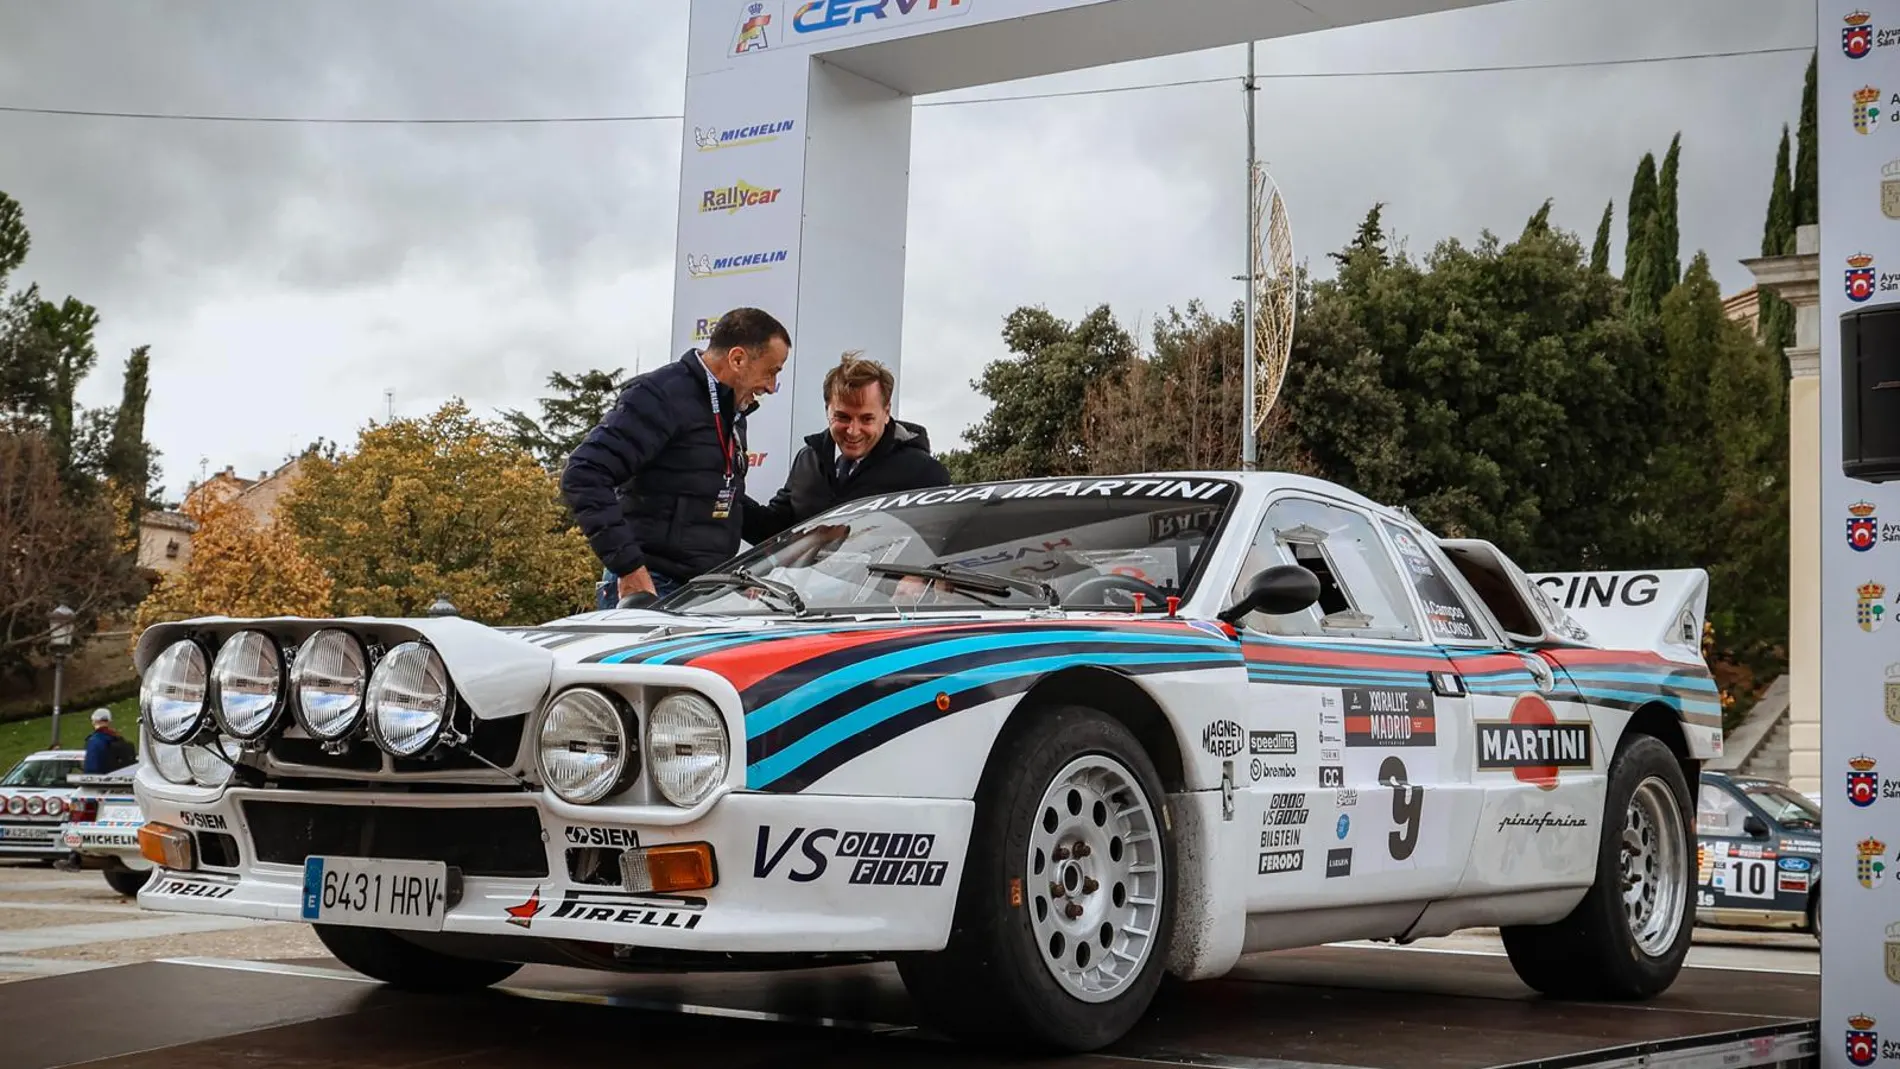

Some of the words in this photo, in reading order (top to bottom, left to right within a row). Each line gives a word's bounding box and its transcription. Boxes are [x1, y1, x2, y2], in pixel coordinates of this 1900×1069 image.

[720, 120, 794, 141] MICHELIN
[702, 186, 782, 208] Rallycar
[713, 250, 788, 270] MICHELIN
[1880, 282, 1898, 292] San
[822, 485, 997, 519] LANCIA
[1001, 480, 1228, 499] MARTINI
[1381, 691, 1409, 712] RALLYE
[1370, 714, 1412, 739] MADRID
[1250, 733, 1295, 751] speedline
[1482, 729, 1586, 761] MARTINI
[1263, 762, 1296, 778] brembo
[1323, 768, 1339, 786] CC
[1270, 793, 1305, 809] OLIO
[1378, 756, 1423, 861] 9
[193, 813, 228, 829] SIEM
[1263, 810, 1275, 825] VS
[1274, 809, 1309, 825] FIAT
[1498, 812, 1588, 833] pininfarina
[82, 835, 139, 845] MICHELIN
[590, 828, 640, 848] SIEM
[1260, 829, 1301, 847] BILSTEIN
[753, 825, 839, 882] VS
[838, 833, 934, 858] OLIO
[1260, 851, 1302, 873] FERODO
[851, 861, 947, 885] FIAT
[1732, 861, 1766, 895] 10
[308, 895, 316, 908] E
[323, 870, 381, 913] 6431
[391, 875, 438, 917] HRV
[552, 890, 708, 930] PIRELLI
